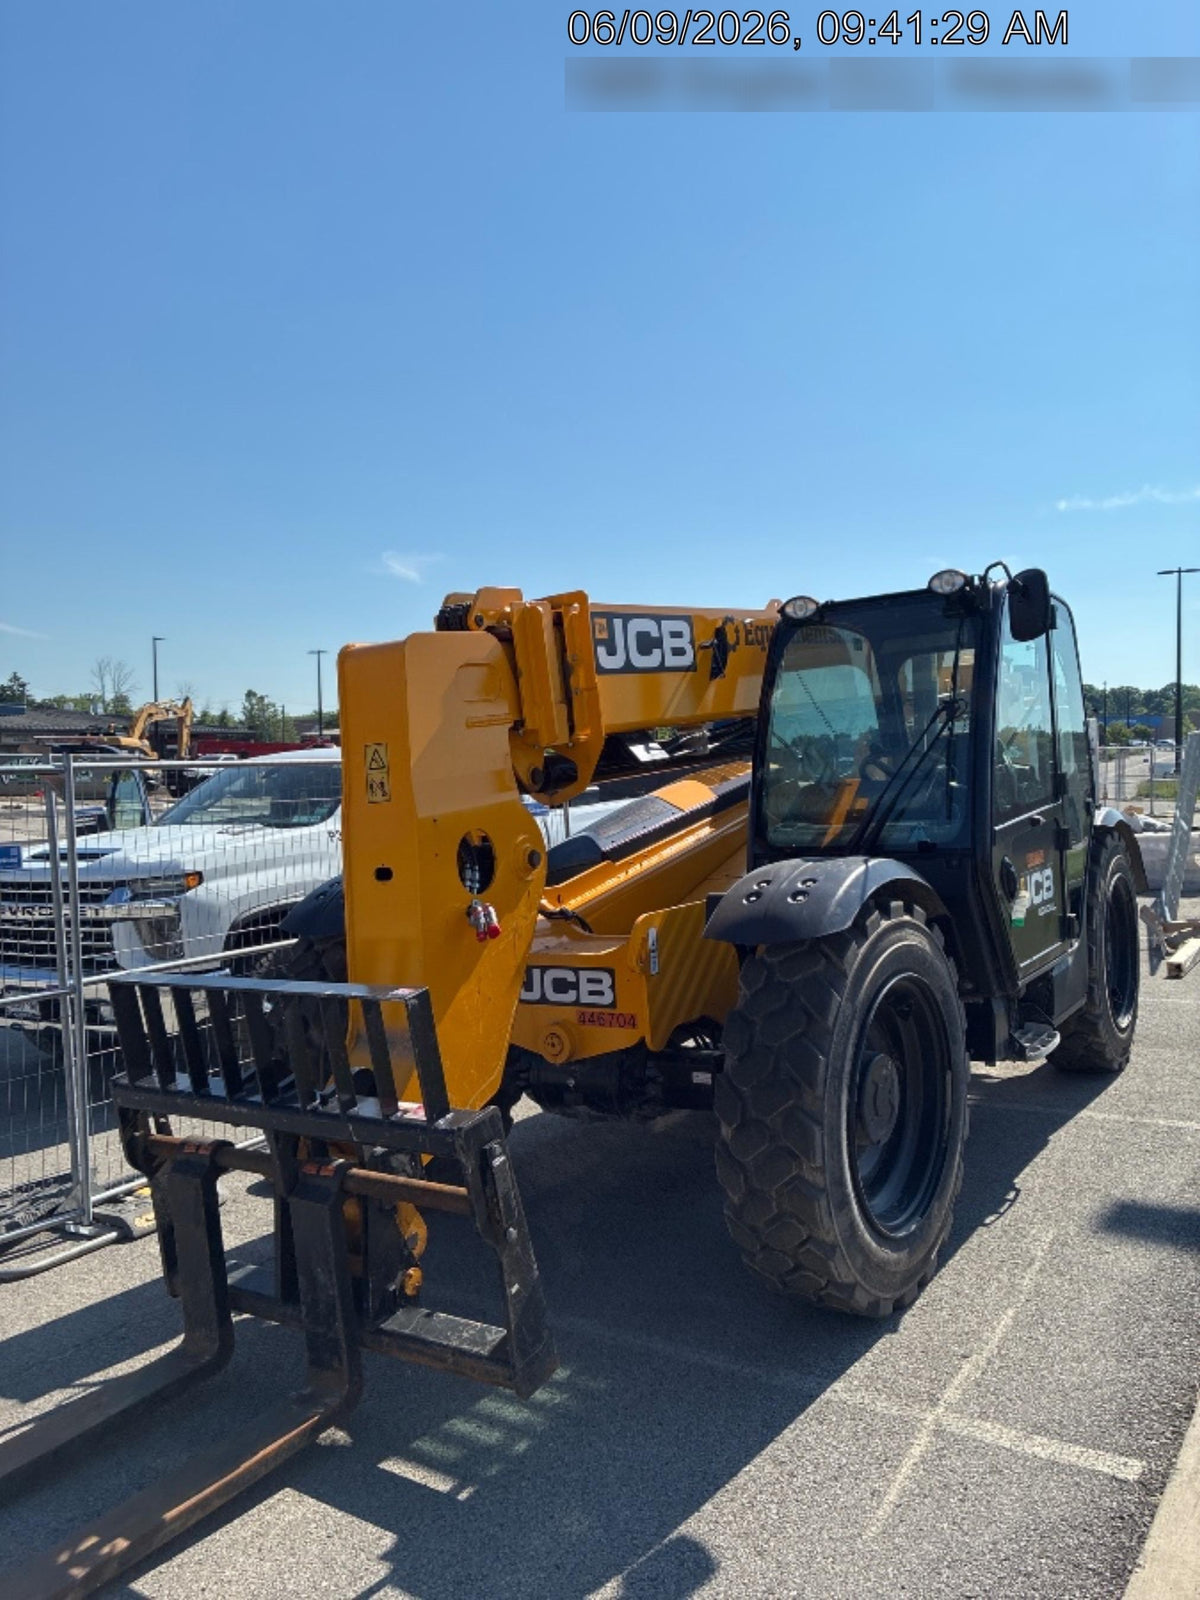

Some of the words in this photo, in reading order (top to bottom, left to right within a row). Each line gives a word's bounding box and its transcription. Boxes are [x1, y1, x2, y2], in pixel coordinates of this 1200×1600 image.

[596, 618, 694, 669] JCB
[520, 968, 615, 1006] JCB
[577, 1012, 638, 1030] 446704
